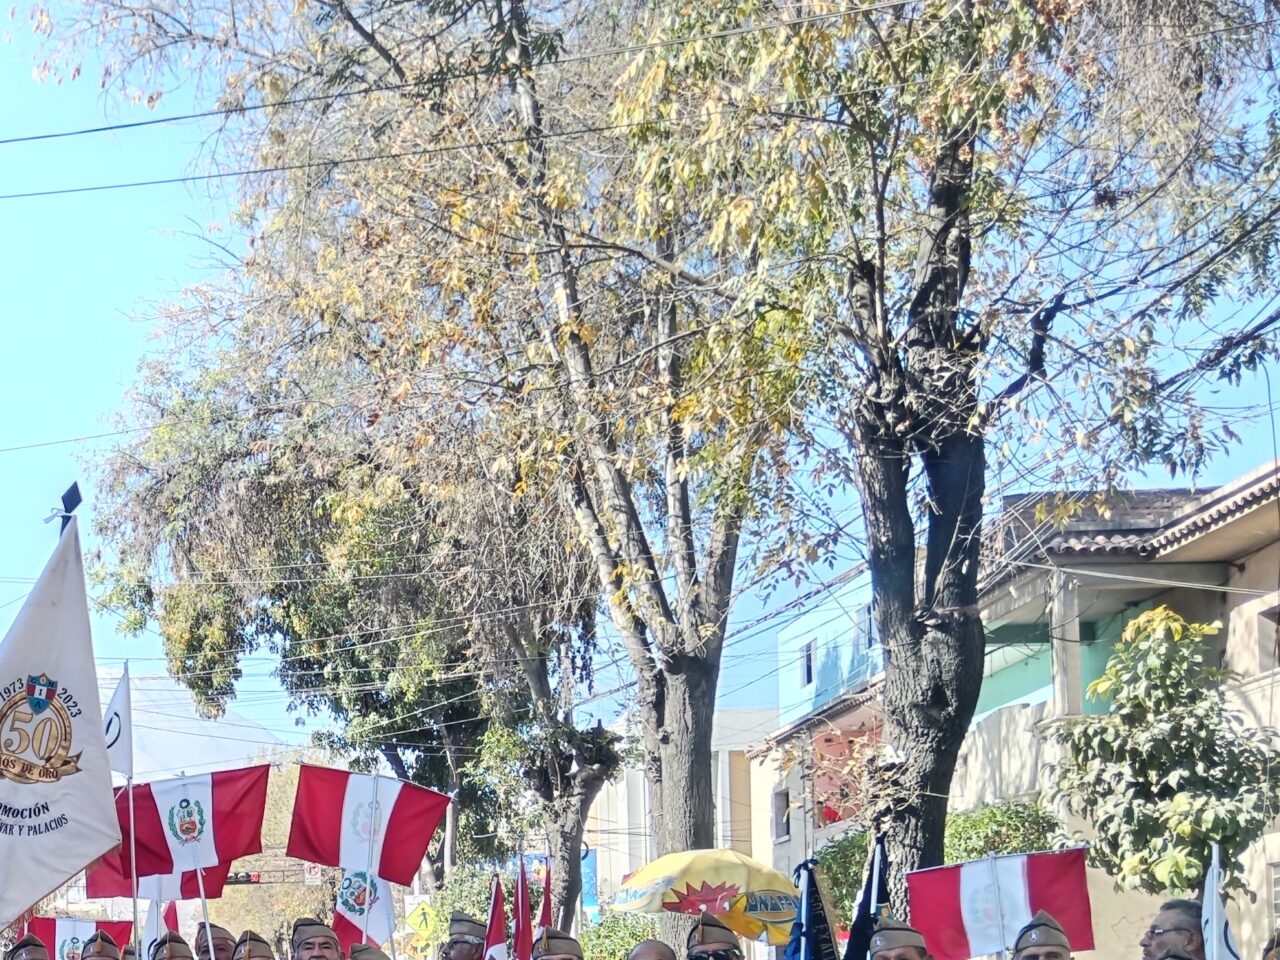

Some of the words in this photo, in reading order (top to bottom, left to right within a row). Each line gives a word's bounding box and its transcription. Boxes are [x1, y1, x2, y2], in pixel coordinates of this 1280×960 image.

[57, 688, 82, 718] 2023
[4, 711, 59, 760] 50
[21, 762, 35, 776] DE
[38, 768, 59, 779] ORO
[18, 825, 25, 836] Y
[27, 813, 69, 837] PALACIOS
